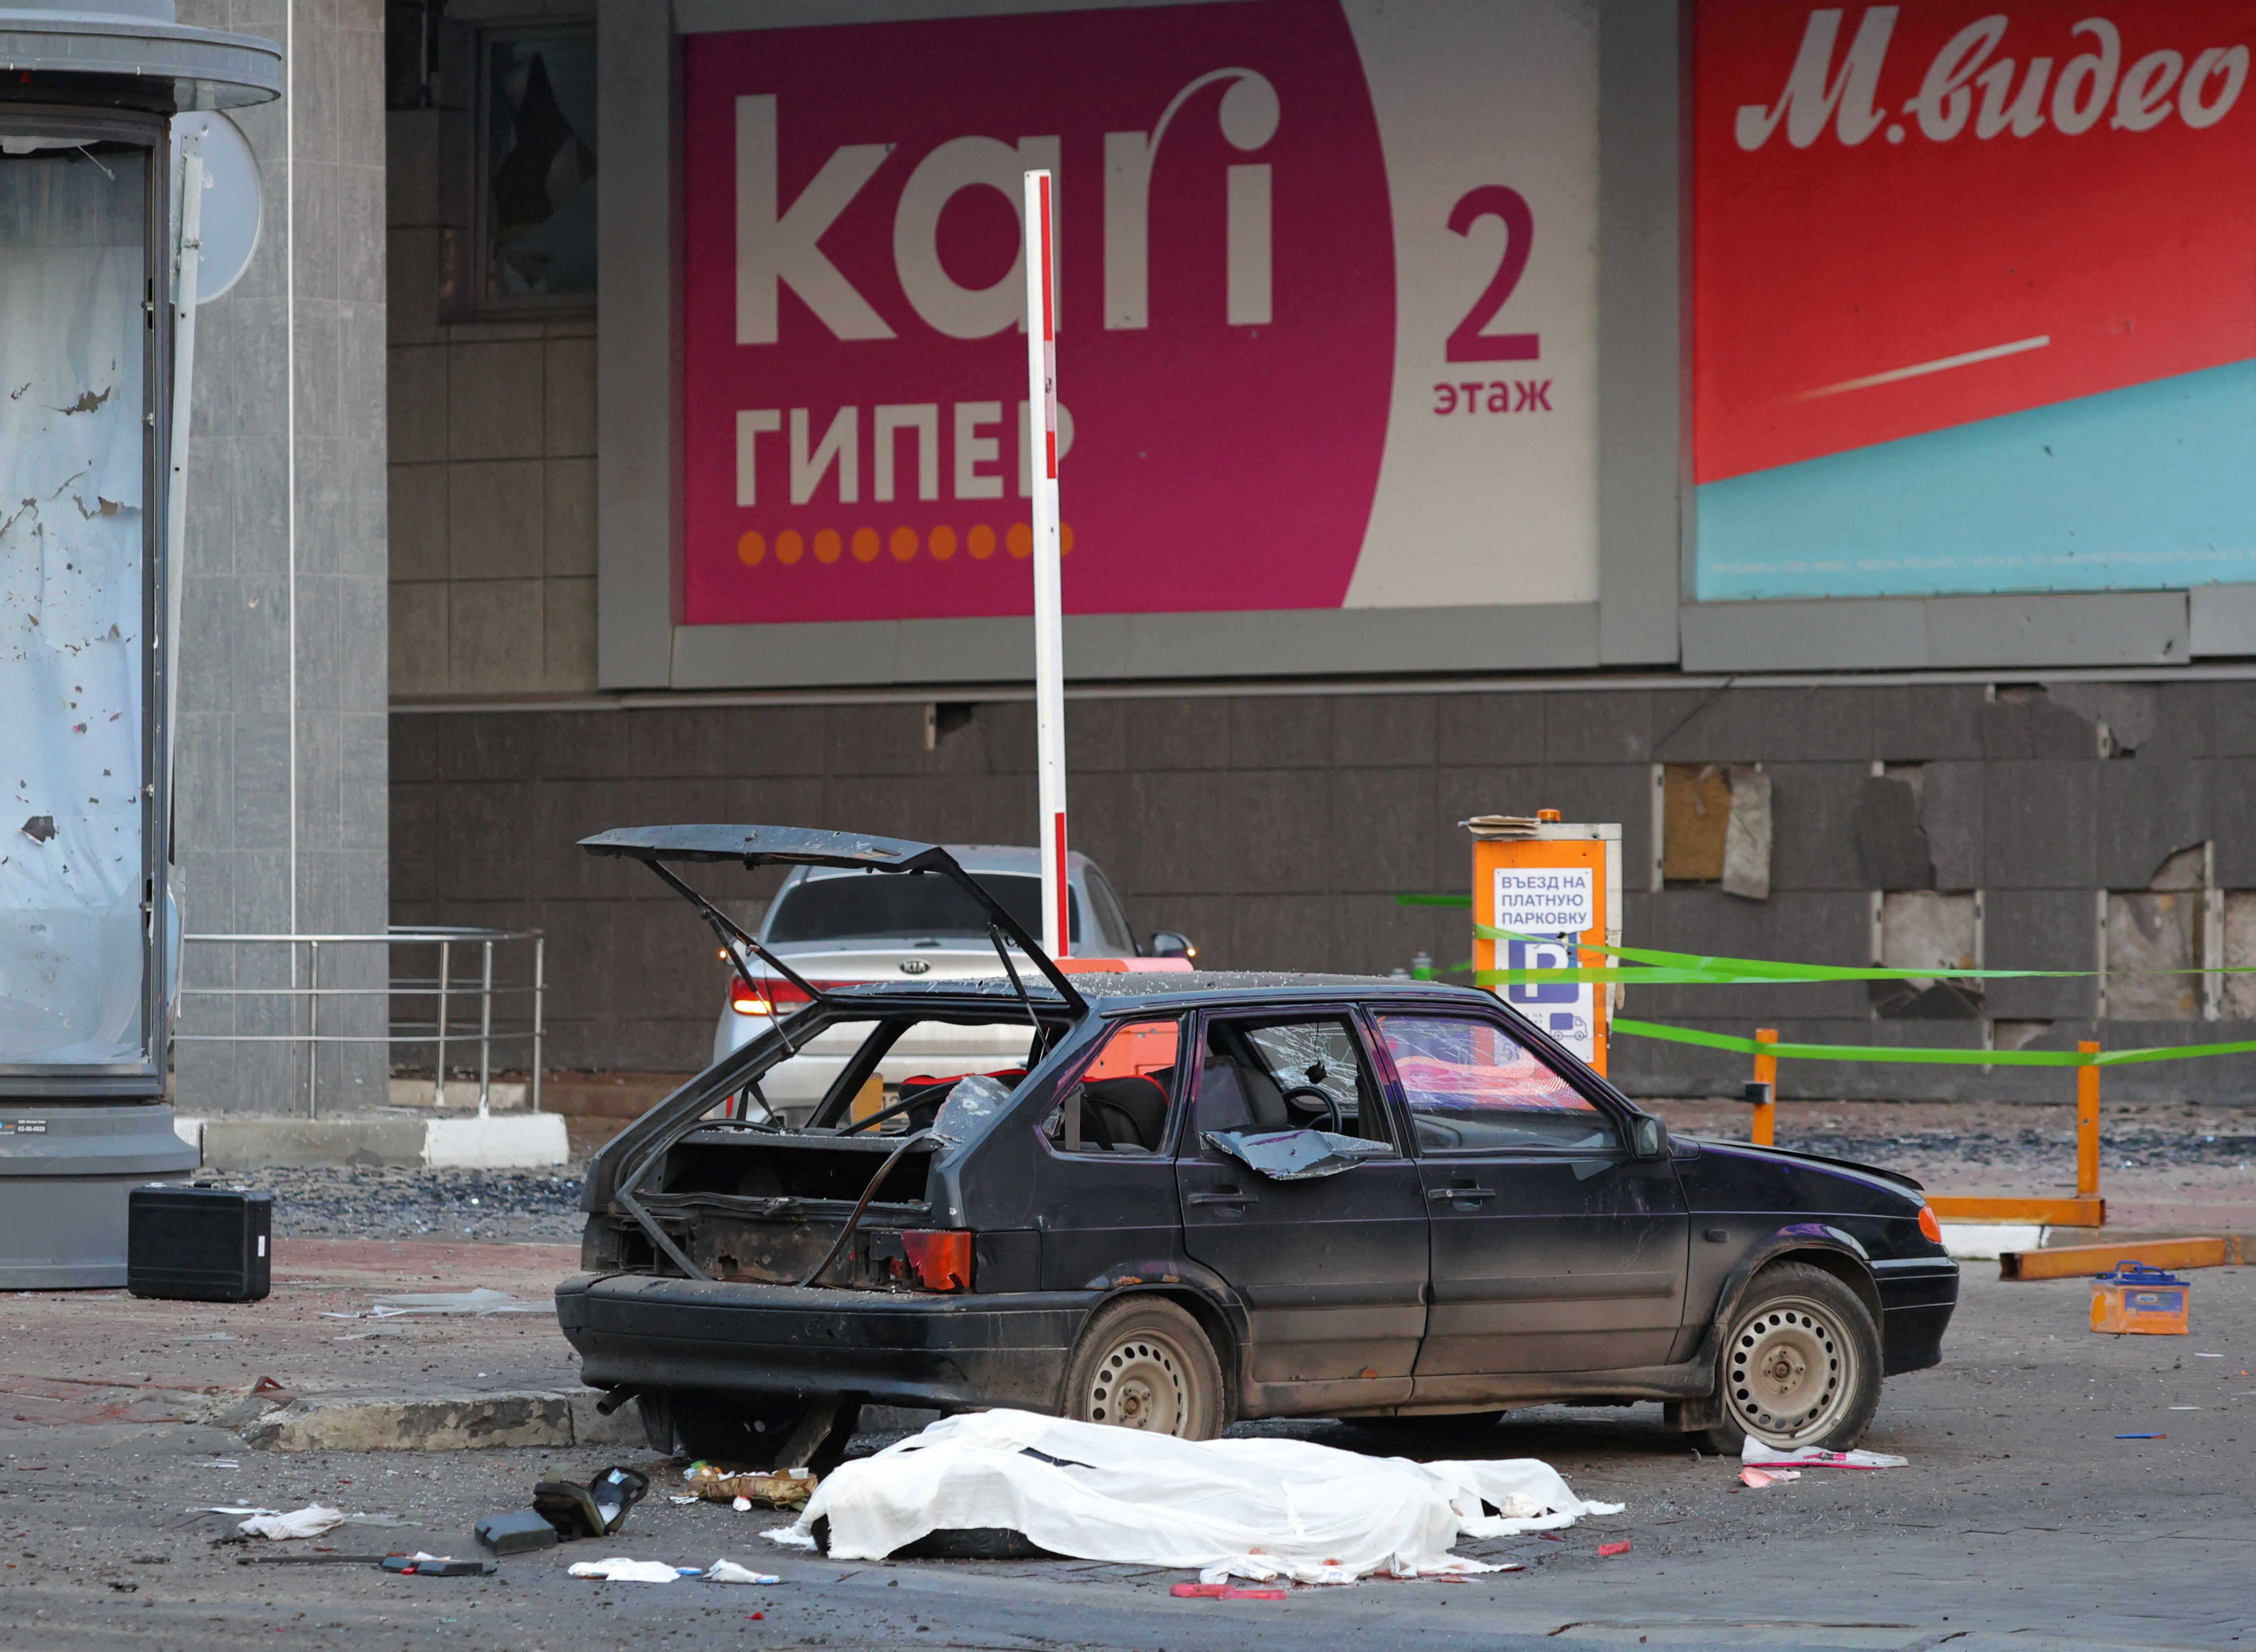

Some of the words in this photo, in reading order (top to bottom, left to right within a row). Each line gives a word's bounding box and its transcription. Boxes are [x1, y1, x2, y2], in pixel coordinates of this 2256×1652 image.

[1735, 5, 2250, 151] М.видео
[735, 66, 1281, 346] kari
[1445, 183, 1541, 363] 2
[1432, 379, 1553, 415] этаж
[1502, 876, 1559, 890] ВЪЕЗД
[1563, 876, 1586, 888] НА
[1502, 894, 1584, 907] ПЛАТНУЮ
[1502, 912, 1587, 925] ПАРКОВКУ
[903, 961, 926, 973] KIA
